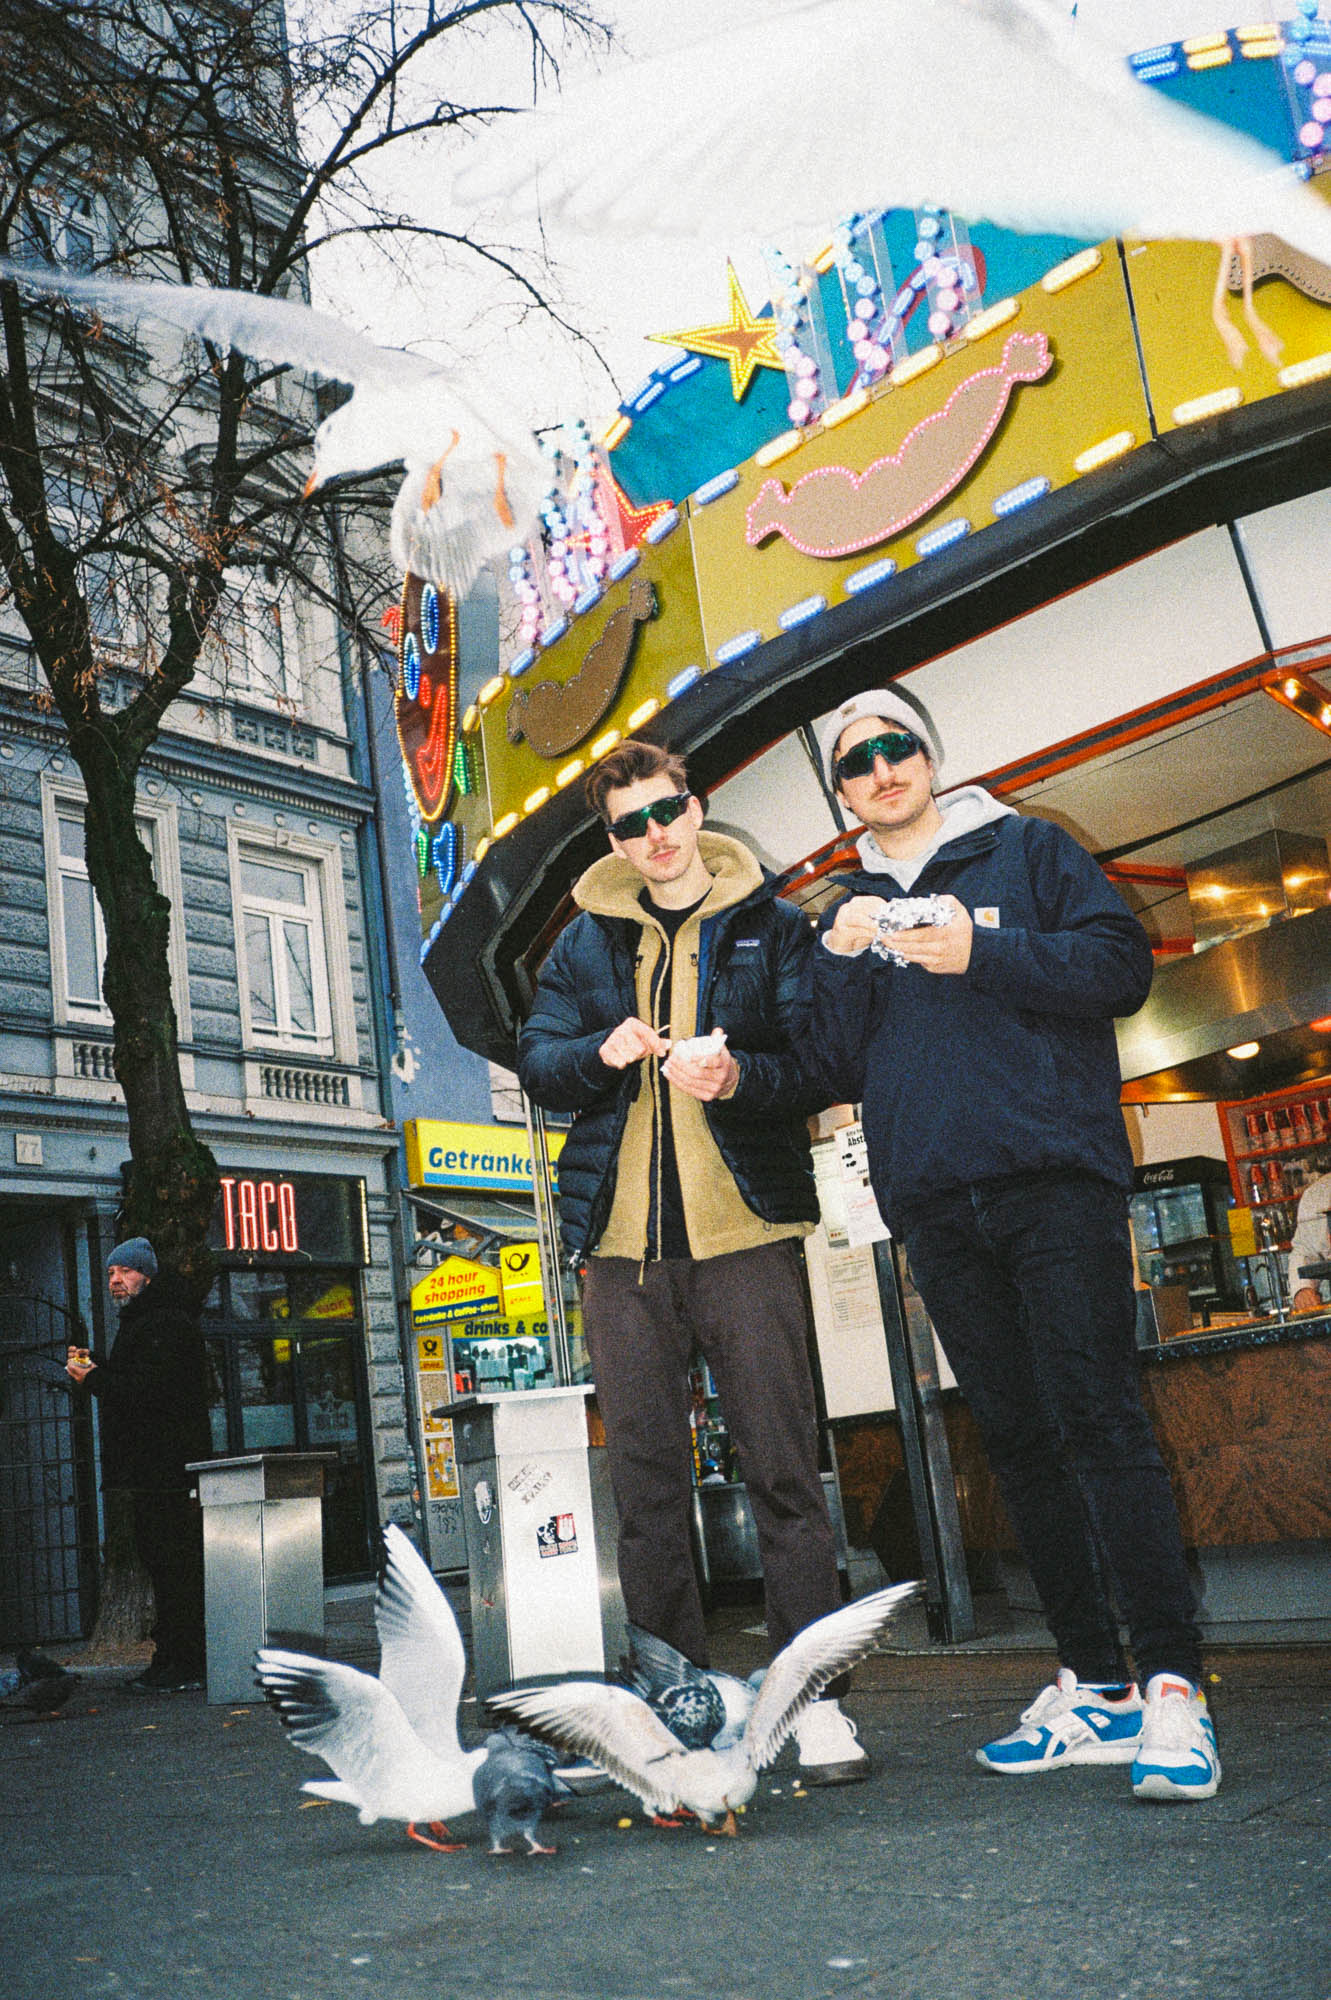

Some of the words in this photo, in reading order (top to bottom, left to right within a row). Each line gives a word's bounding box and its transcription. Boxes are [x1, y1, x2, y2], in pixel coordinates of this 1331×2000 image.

[19, 1140, 38, 1157] 77
[847, 1135, 864, 1147] Abst
[219, 1177, 298, 1252] TACO
[430, 1276, 445, 1289] 24
[447, 1271, 479, 1286] hour
[424, 1284, 486, 1305] shopping
[464, 1321, 510, 1336] drinks
[515, 1320, 526, 1335] &
